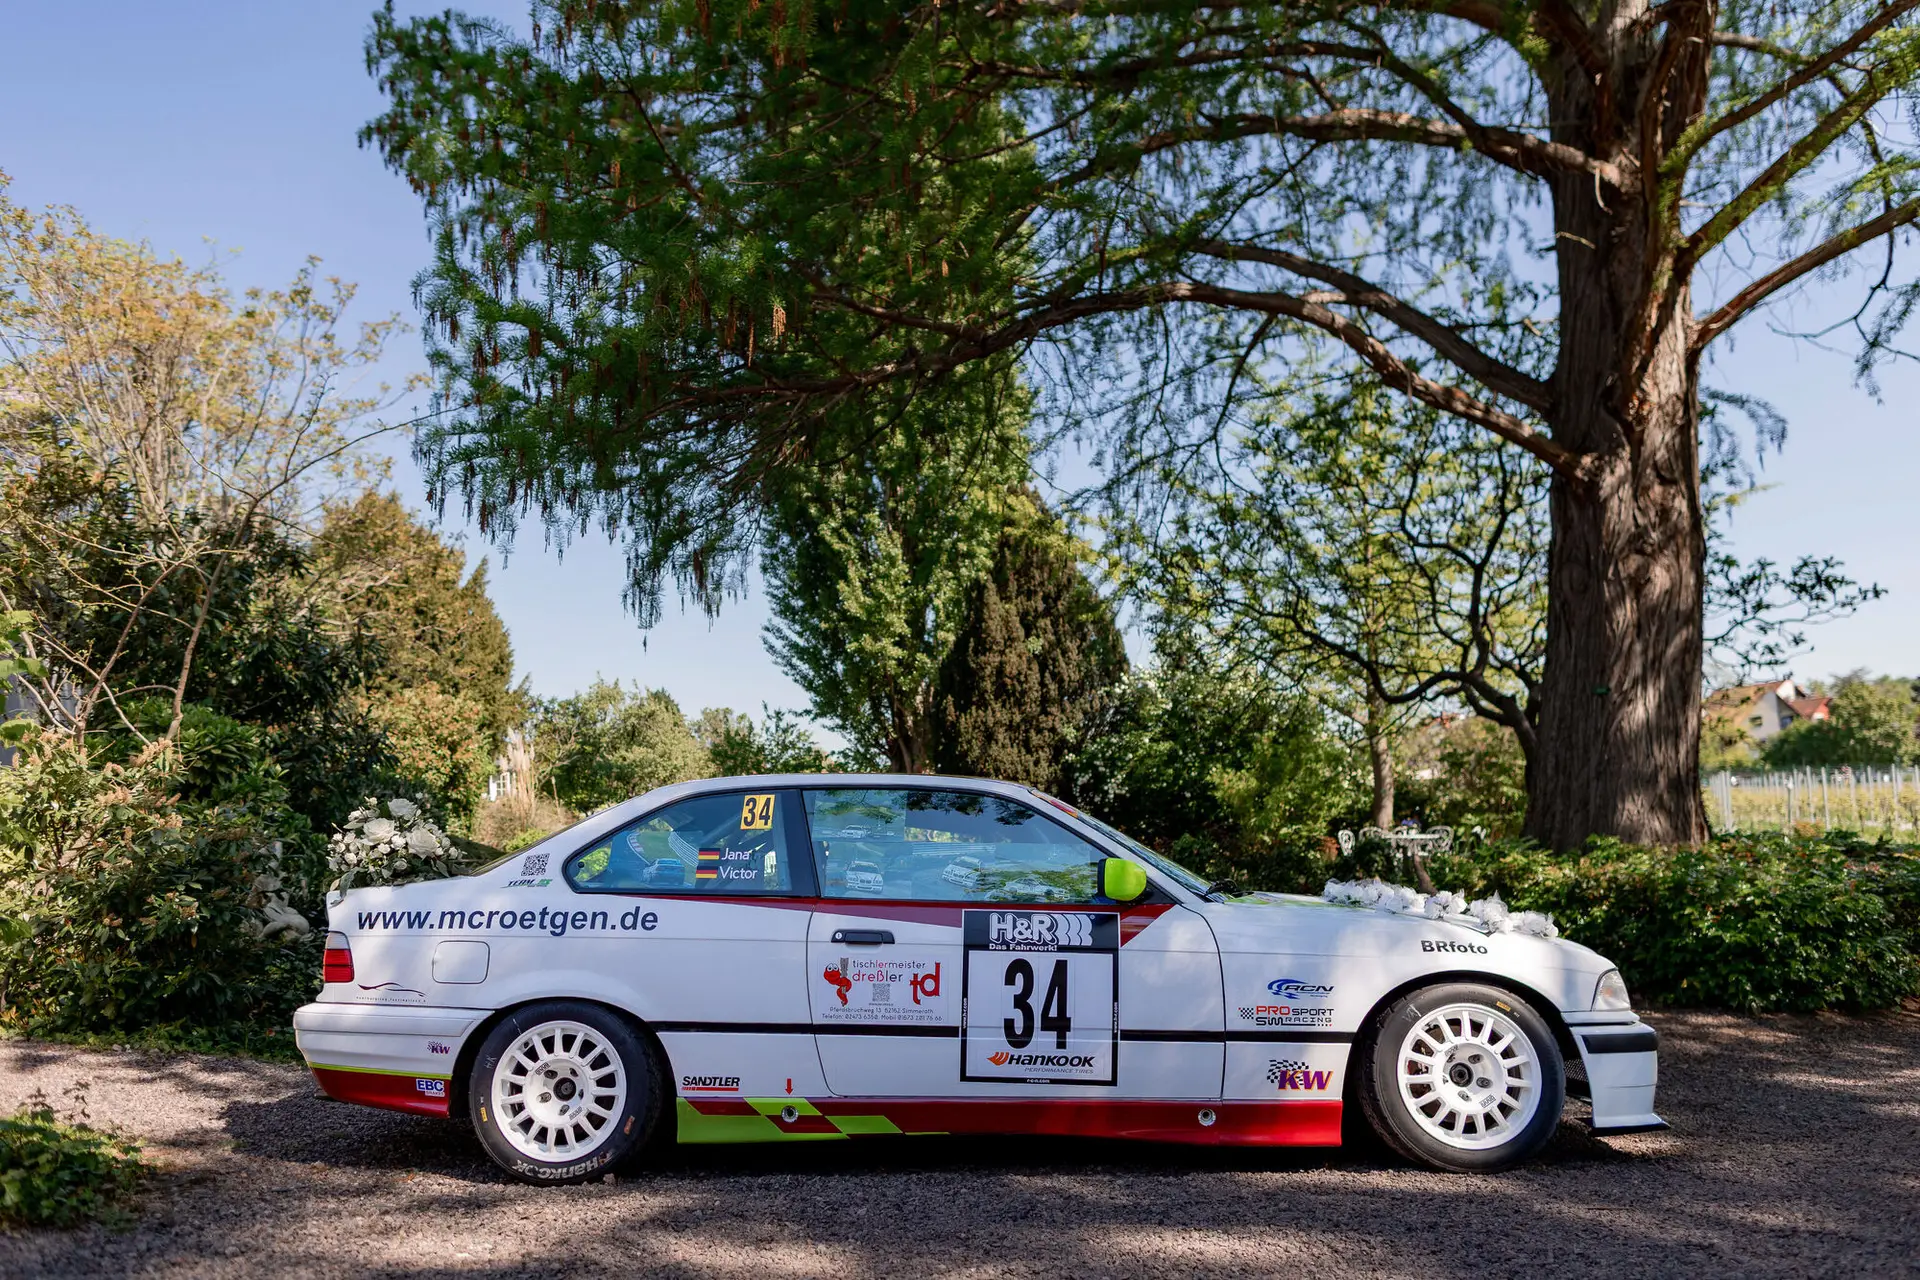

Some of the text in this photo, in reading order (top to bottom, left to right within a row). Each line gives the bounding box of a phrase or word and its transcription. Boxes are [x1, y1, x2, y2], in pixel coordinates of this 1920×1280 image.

[743, 797, 772, 827] 34
[721, 847, 750, 860] Jana
[720, 866, 757, 879] Victor
[357, 905, 658, 936] www.mcroetgen.de
[989, 912, 1058, 945] H&R
[1009, 943, 1058, 951] Fahrwerk!
[1420, 940, 1488, 954] BRfoto
[852, 960, 926, 969] tischlermeister
[852, 970, 903, 982] dreßler
[1003, 958, 1071, 1050] 34
[1256, 1005, 1334, 1016] PRO SPORT
[431, 1045, 450, 1054] KW
[417, 1080, 443, 1092] EBC
[682, 1076, 740, 1087] SANDTLER
[1278, 1069, 1333, 1091] KW
